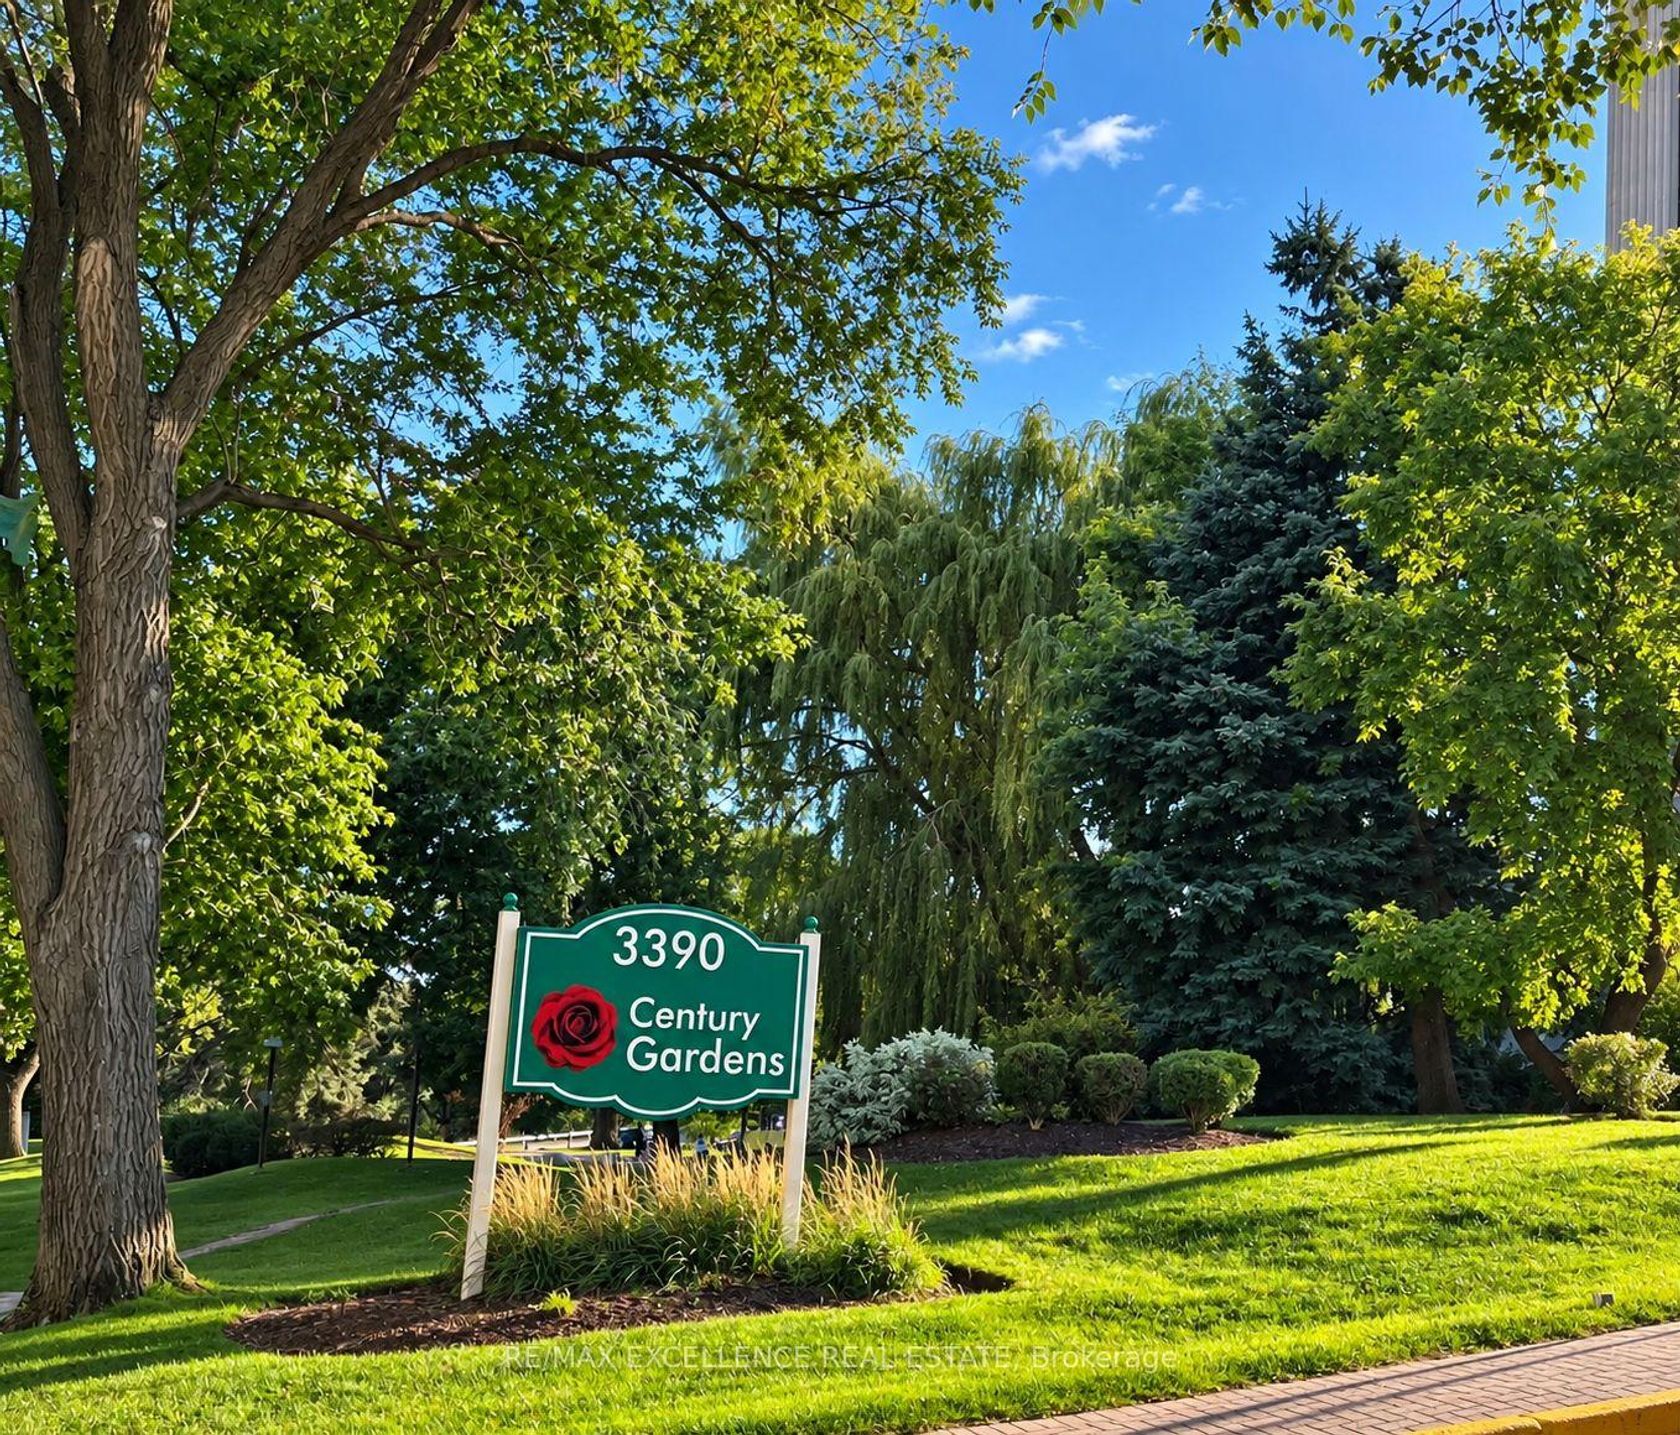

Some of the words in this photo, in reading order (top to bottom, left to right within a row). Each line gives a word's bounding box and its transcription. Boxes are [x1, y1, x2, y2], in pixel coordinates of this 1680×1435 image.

[612, 925, 726, 972] 3390
[629, 996, 761, 1041] Century
[626, 1035, 785, 1076] Gardens
